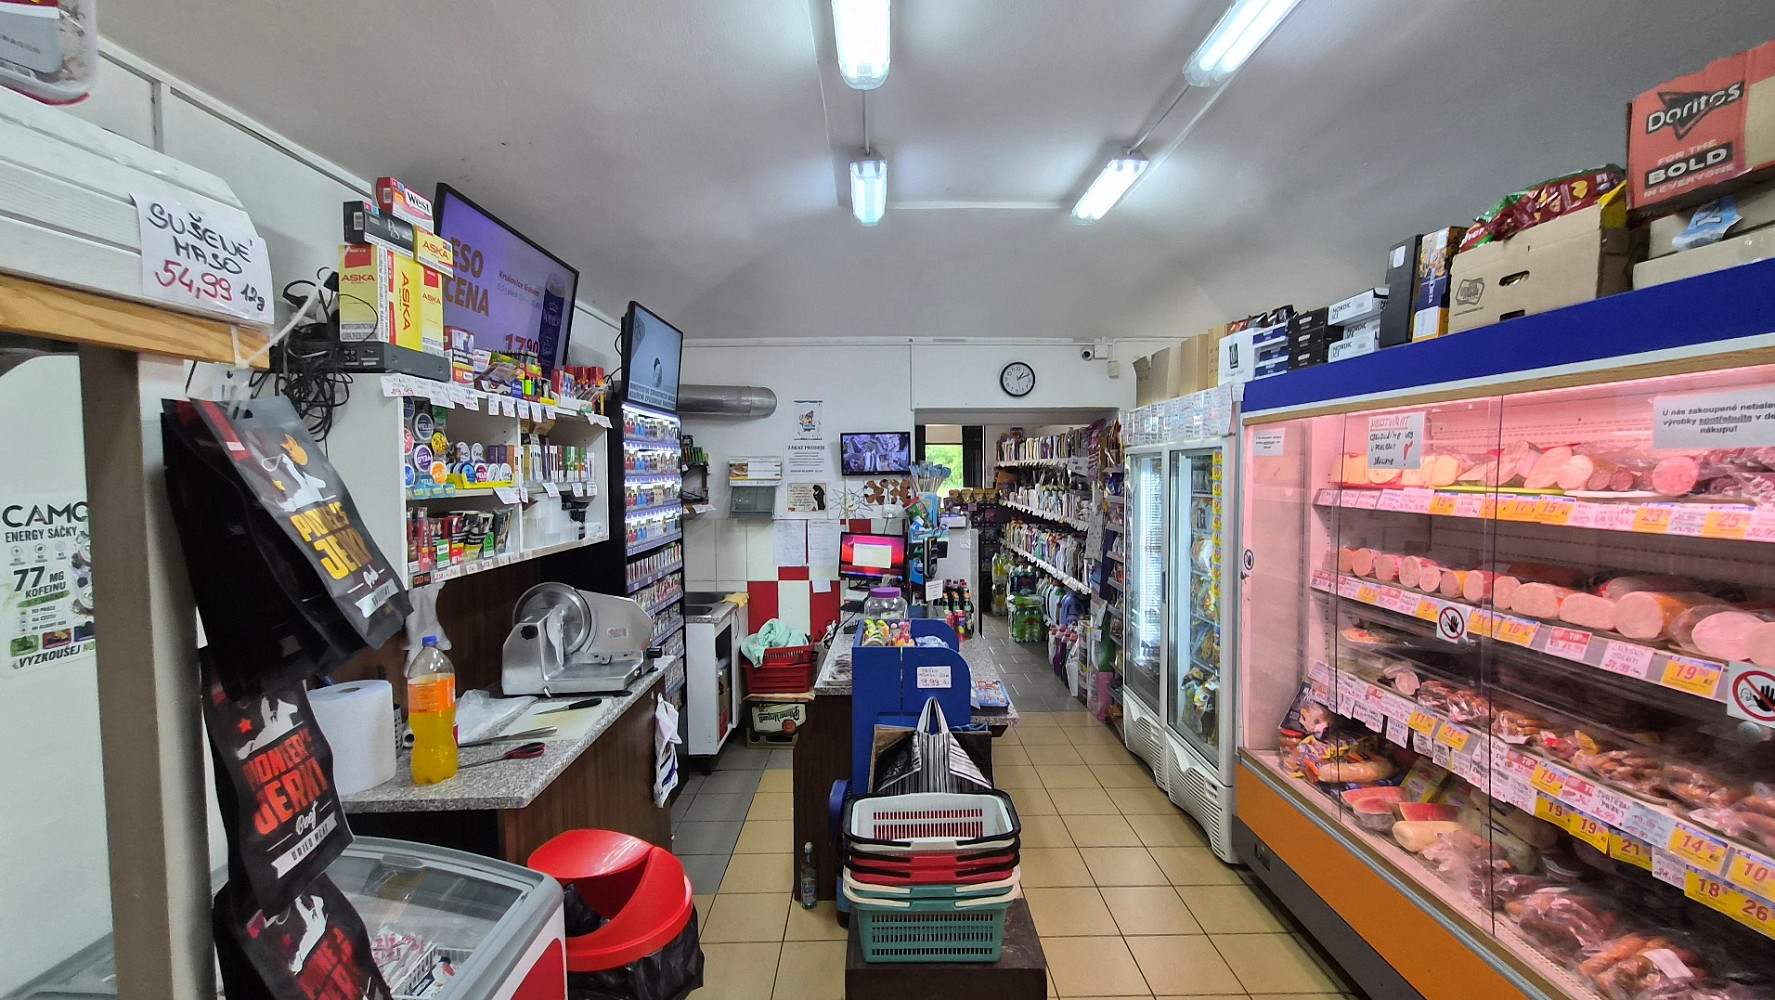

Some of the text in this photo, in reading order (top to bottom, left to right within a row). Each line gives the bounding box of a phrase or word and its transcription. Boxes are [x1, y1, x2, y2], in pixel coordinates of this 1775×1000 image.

[1648, 83, 1741, 132] Doritos
[1657, 139, 1718, 166] FOR THE
[1648, 148, 1727, 185] BOLD
[1643, 163, 1735, 199] IN EVERYONE
[407, 192, 430, 213] West
[422, 240, 450, 261] ASKA
[155, 259, 233, 302] 54,99
[341, 274, 375, 282] ASKA
[400, 272, 411, 331] ASKA
[422, 292, 441, 305] ASKA
[444, 275, 489, 317] CENA
[1671, 408, 1686, 416] nás
[1688, 404, 1738, 415] zakoupené
[1663, 417, 1697, 428] výrobky
[1699, 414, 1752, 425] spotřebujte
[1700, 425, 1738, 434] nákupu!
[5, 525, 78, 543] ENERGY SÁČKY
[13, 565, 65, 592] 77 MG
[25, 581, 67, 599] KOFEINU
[19, 644, 81, 668] VYZKOUŠEJ
[1676, 664, 1698, 680] 19
[1540, 769, 1557, 784] 19
[295, 800, 319, 836] Beef
[1548, 802, 1563, 817] 19
[1581, 818, 1597, 835] 19
[291, 838, 314, 861] DRIED
[1620, 839, 1640, 856] 21
[1682, 835, 1704, 853] 14
[1743, 862, 1768, 882] 10
[1698, 878, 1720, 898] 18
[1742, 899, 1768, 922] 26
